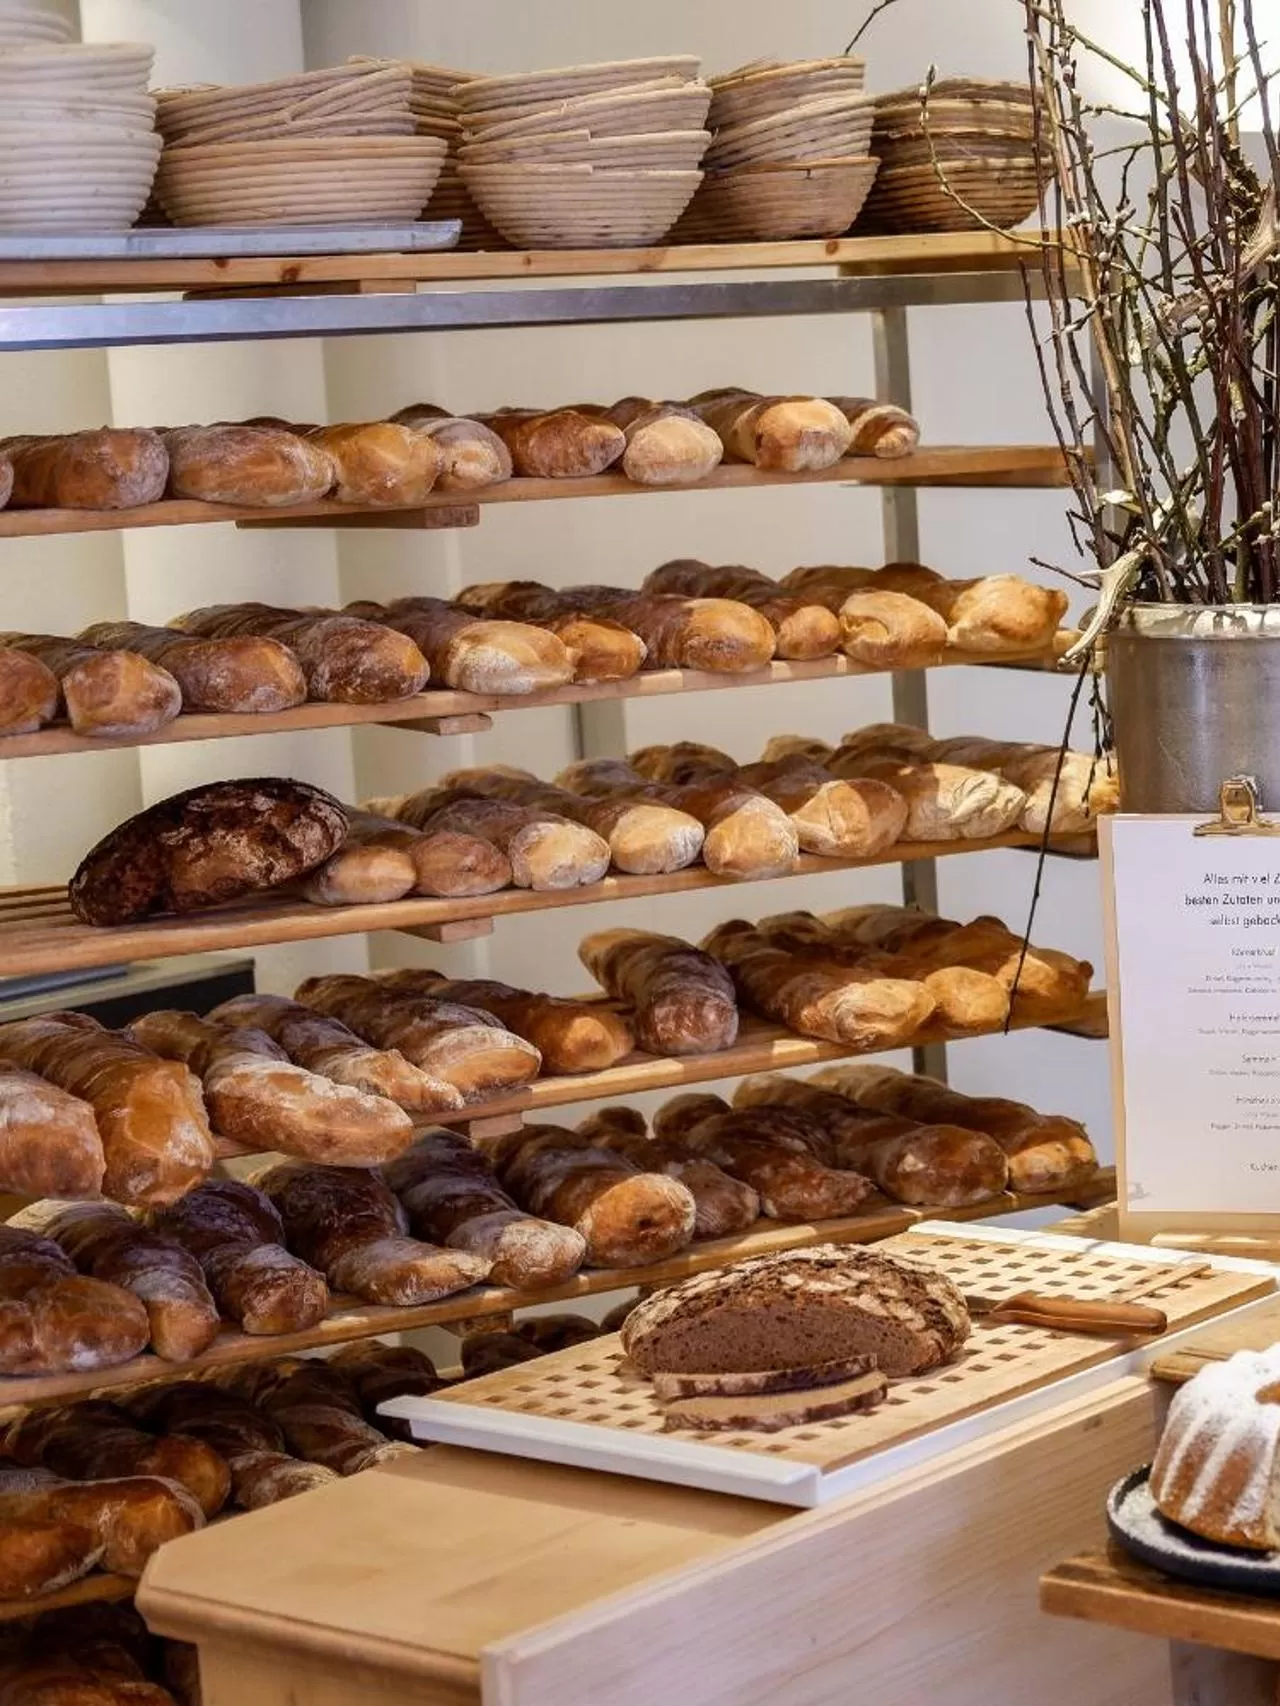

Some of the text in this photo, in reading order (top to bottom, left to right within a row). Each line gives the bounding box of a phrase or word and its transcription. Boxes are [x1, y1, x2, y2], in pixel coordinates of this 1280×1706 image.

[1203, 873, 1229, 885] Alles
[1232, 873, 1249, 885] mit
[1251, 873, 1270, 885] vel
[1185, 894, 1219, 906] besten
[1222, 893, 1263, 906] Zutaten
